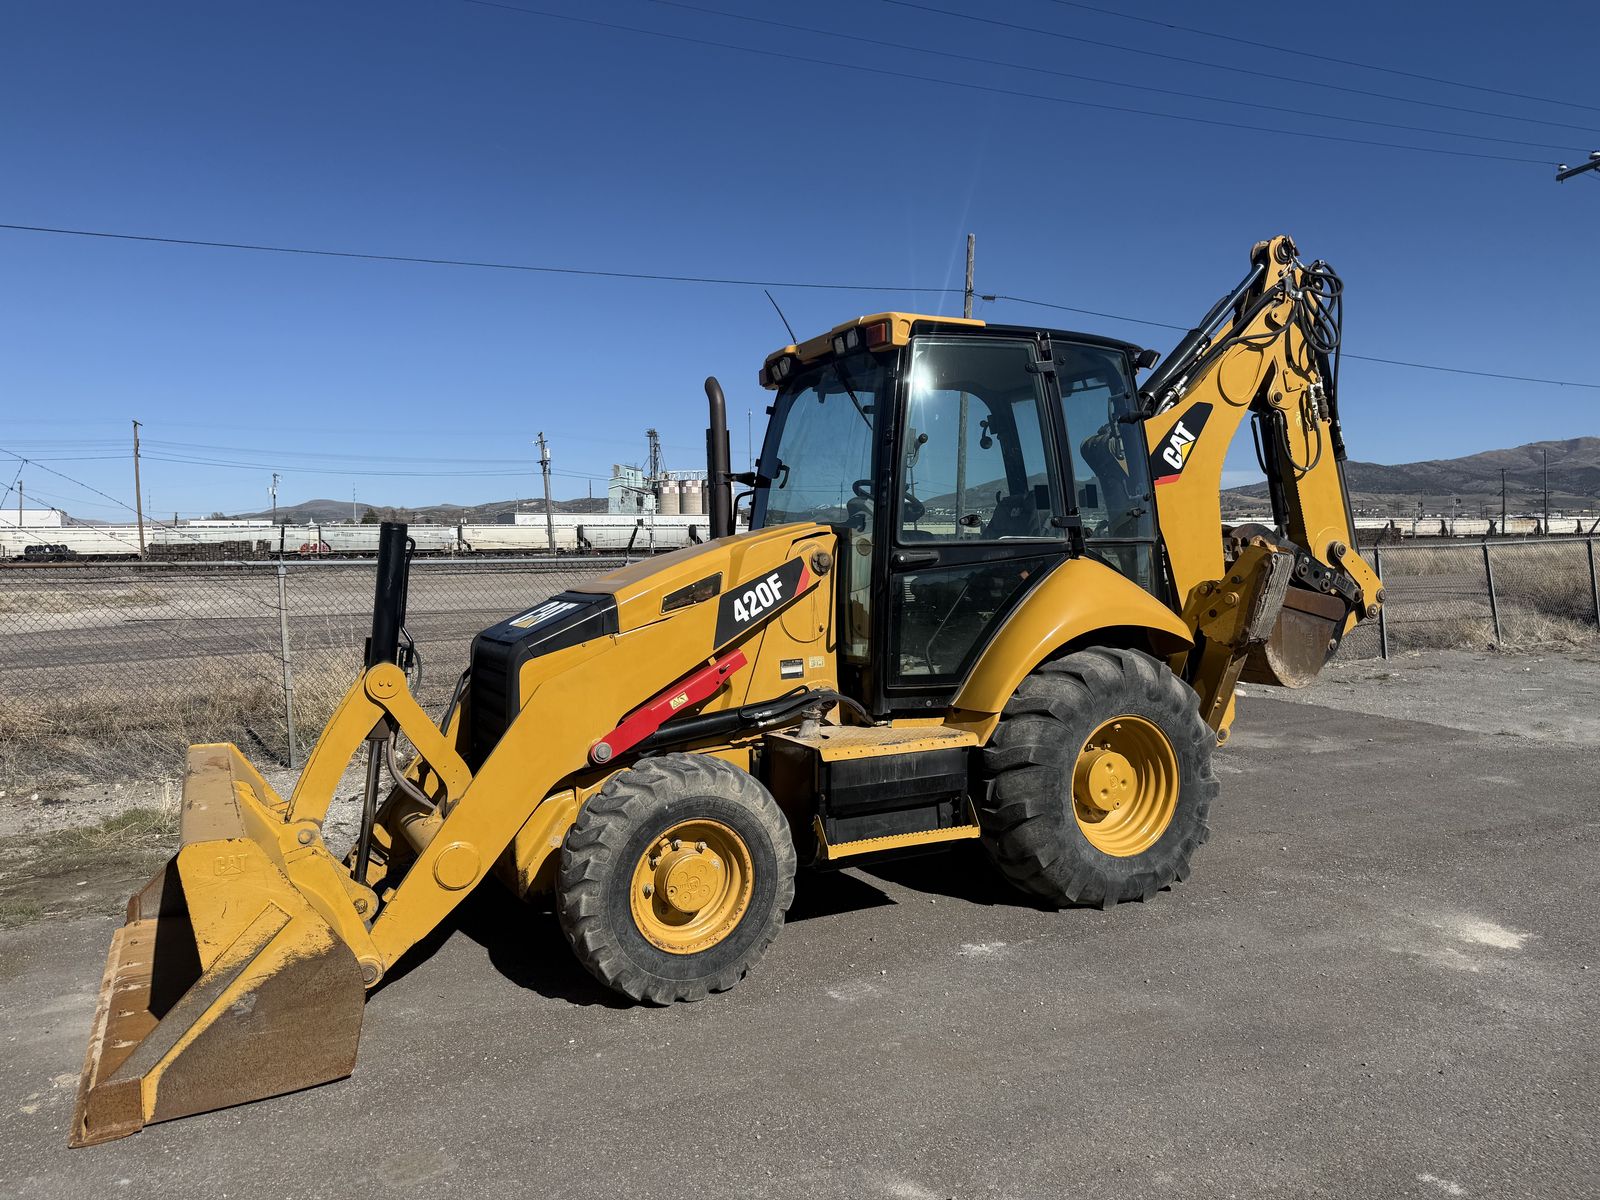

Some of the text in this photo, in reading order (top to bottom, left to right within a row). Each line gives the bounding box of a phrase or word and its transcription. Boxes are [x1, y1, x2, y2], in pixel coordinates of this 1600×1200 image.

[1163, 421, 1196, 470] CAT
[508, 601, 579, 628] CAT
[733, 572, 783, 622] 420F
[213, 853, 248, 876] CAT
